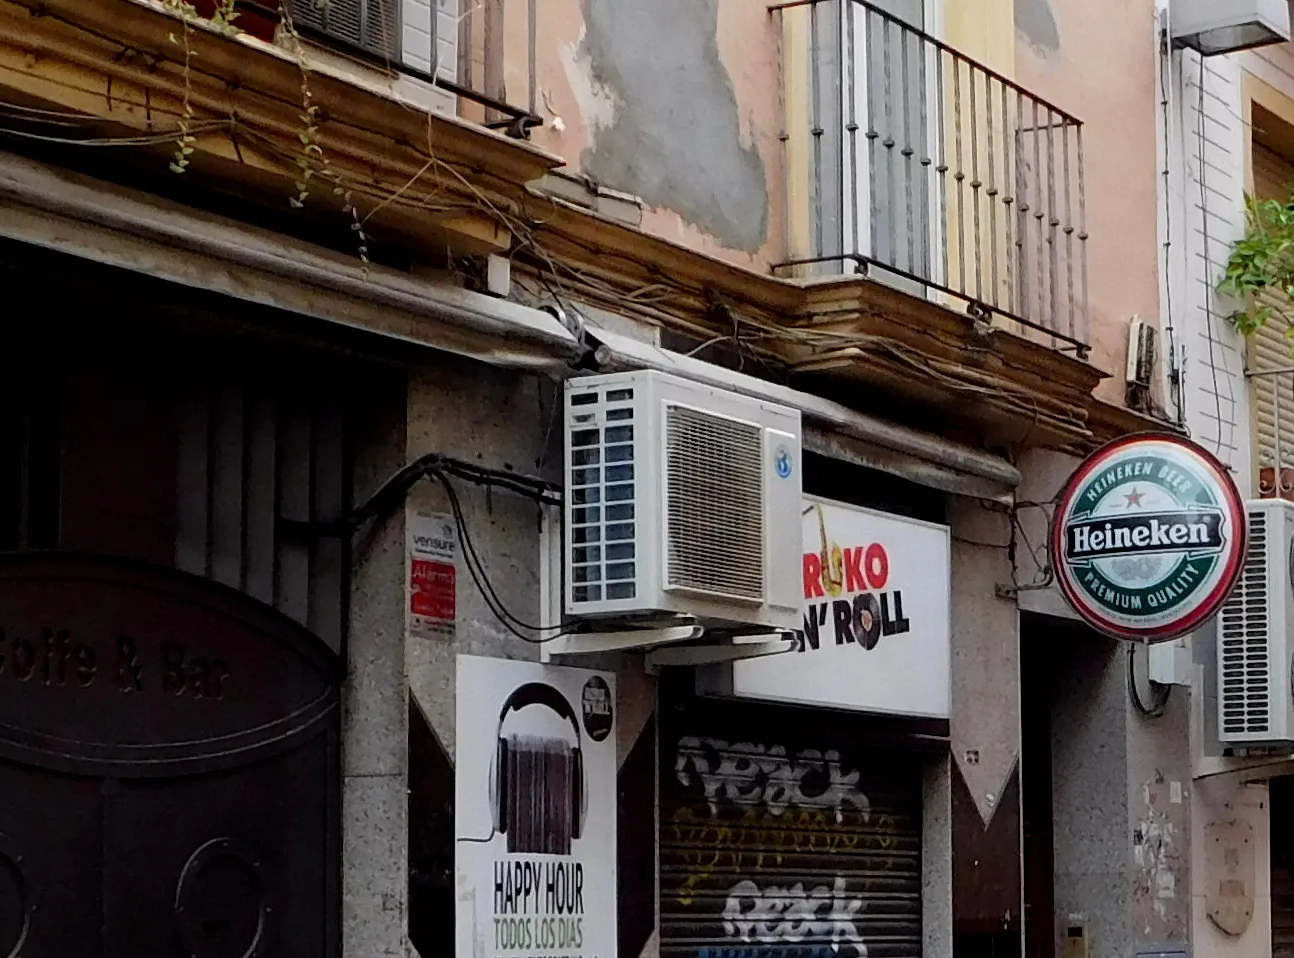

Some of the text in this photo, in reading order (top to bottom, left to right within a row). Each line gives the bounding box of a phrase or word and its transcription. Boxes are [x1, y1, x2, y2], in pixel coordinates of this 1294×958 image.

[1086, 461, 1193, 502] HEINEKEN BEER
[1073, 519, 1210, 553] Heineken
[1084, 563, 1199, 610] PREMIUM QUALITY
[160, 639, 231, 701] Bar
[493, 860, 585, 915] HAPPY HOUR
[493, 917, 583, 950] TODOS LOS DIAS
